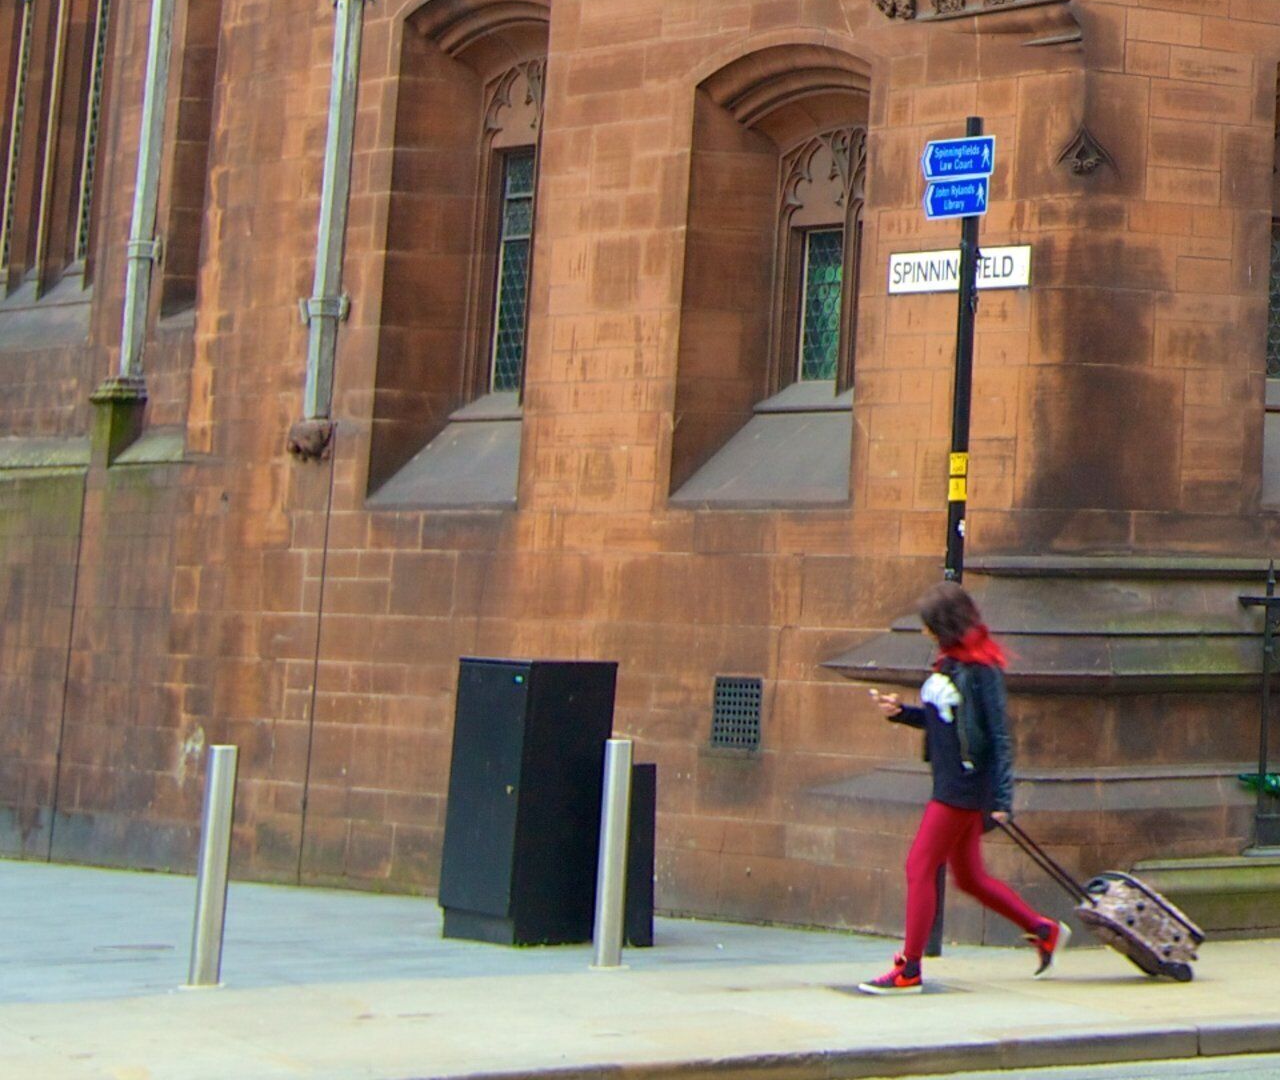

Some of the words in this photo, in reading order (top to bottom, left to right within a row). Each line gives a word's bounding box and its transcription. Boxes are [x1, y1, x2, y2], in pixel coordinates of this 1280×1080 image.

[934, 145, 980, 160] Spinningfields
[940, 161, 953, 171] Law
[954, 159, 973, 170] Court
[935, 186, 950, 198] John
[951, 184, 975, 198] Rylands
[943, 199, 965, 211] Library
[893, 255, 1014, 284] SPINNINIELD
